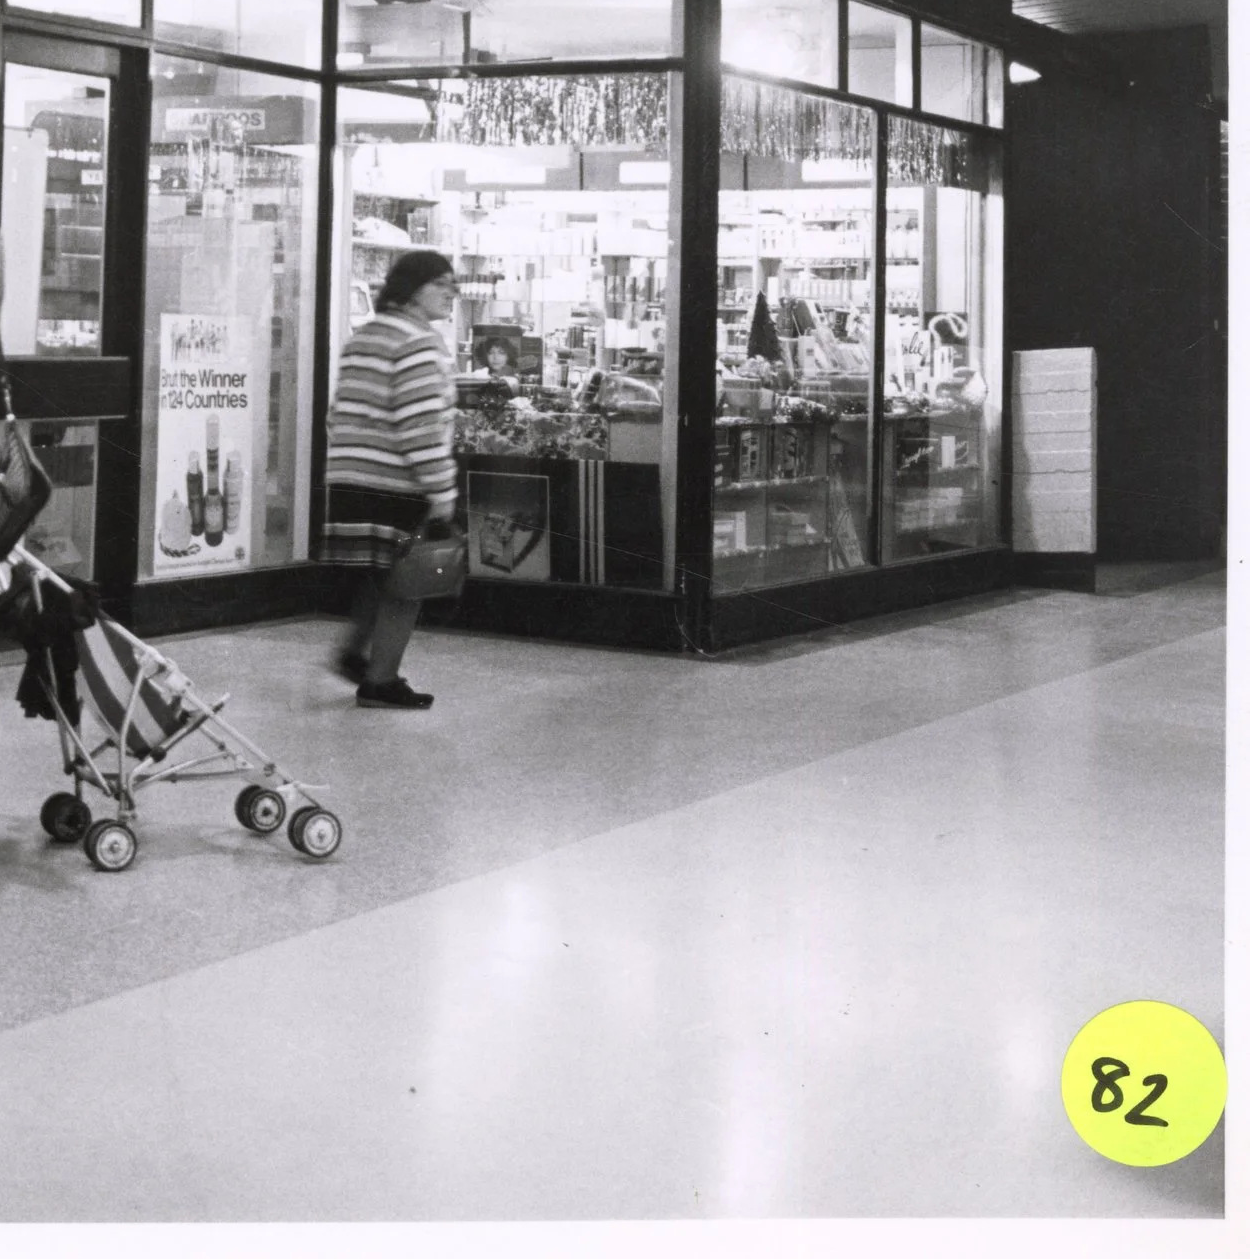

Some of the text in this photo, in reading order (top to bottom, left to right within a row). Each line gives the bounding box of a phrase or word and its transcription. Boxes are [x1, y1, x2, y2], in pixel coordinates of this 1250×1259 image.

[180, 368, 197, 388] the
[198, 368, 248, 388] Winner
[185, 389, 249, 409] Countries
[1091, 1056, 1170, 1127] 82
